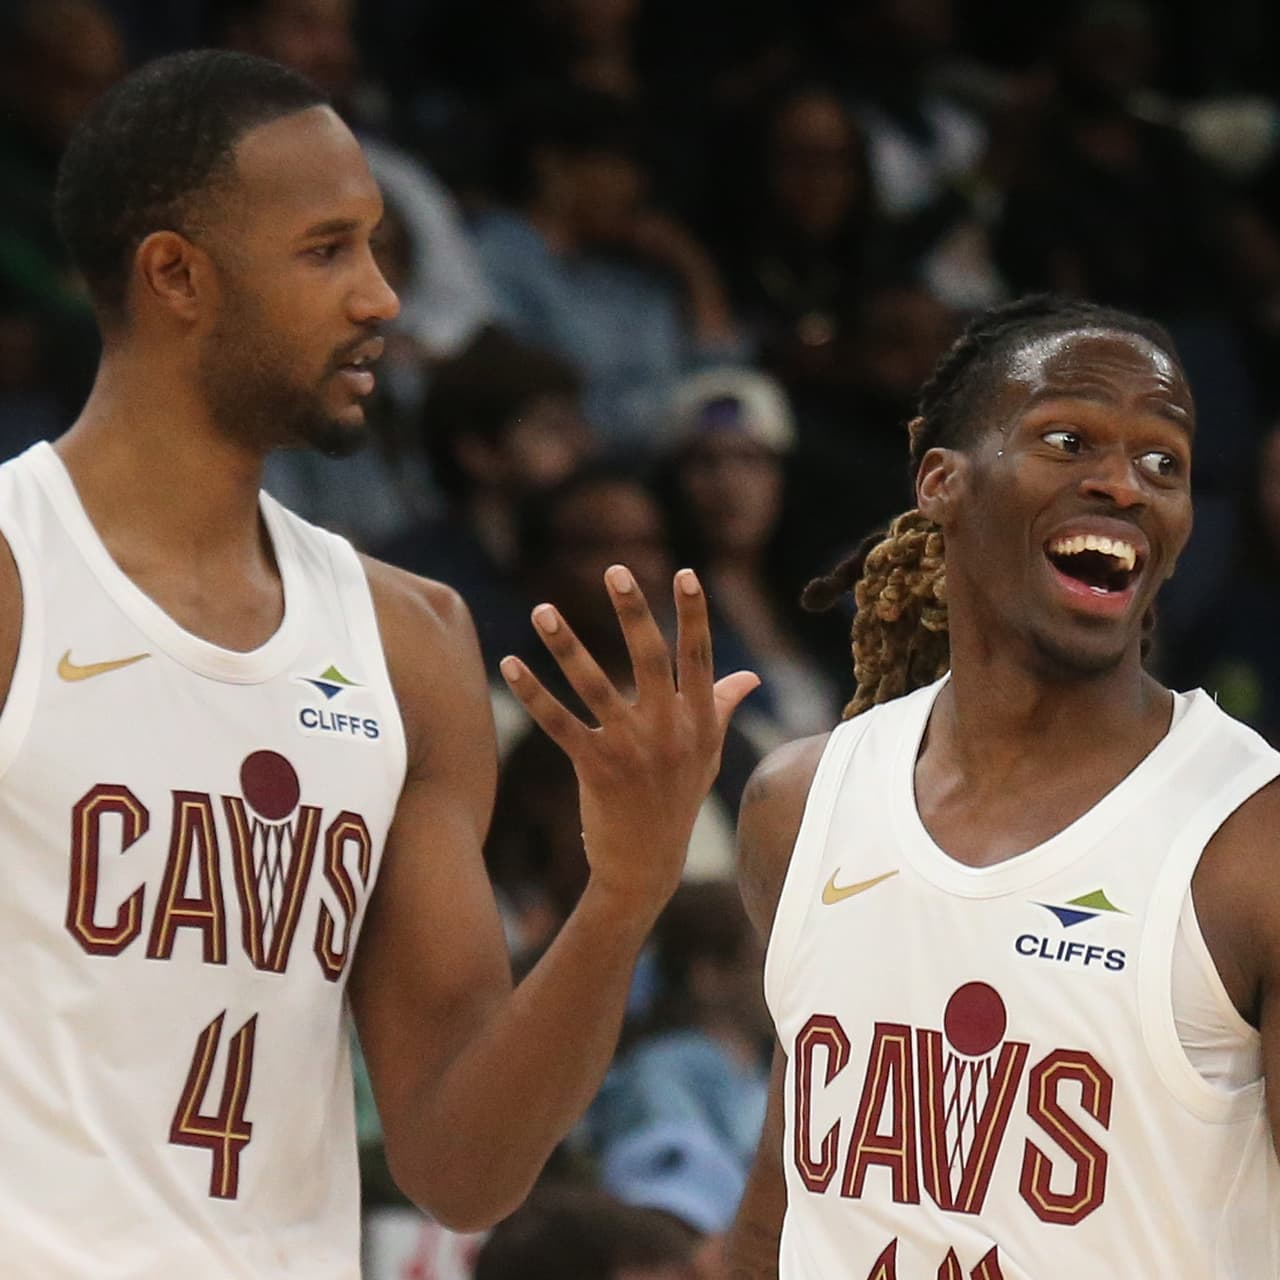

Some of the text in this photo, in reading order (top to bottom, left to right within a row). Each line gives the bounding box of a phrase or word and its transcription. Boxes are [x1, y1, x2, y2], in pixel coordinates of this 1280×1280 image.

[299, 707, 380, 739] CLIFFS
[65, 782, 372, 983] CAVS
[1014, 934, 1126, 971] CLIFFS
[168, 1008, 258, 1200] 4
[794, 1013, 1114, 1226] CAVS
